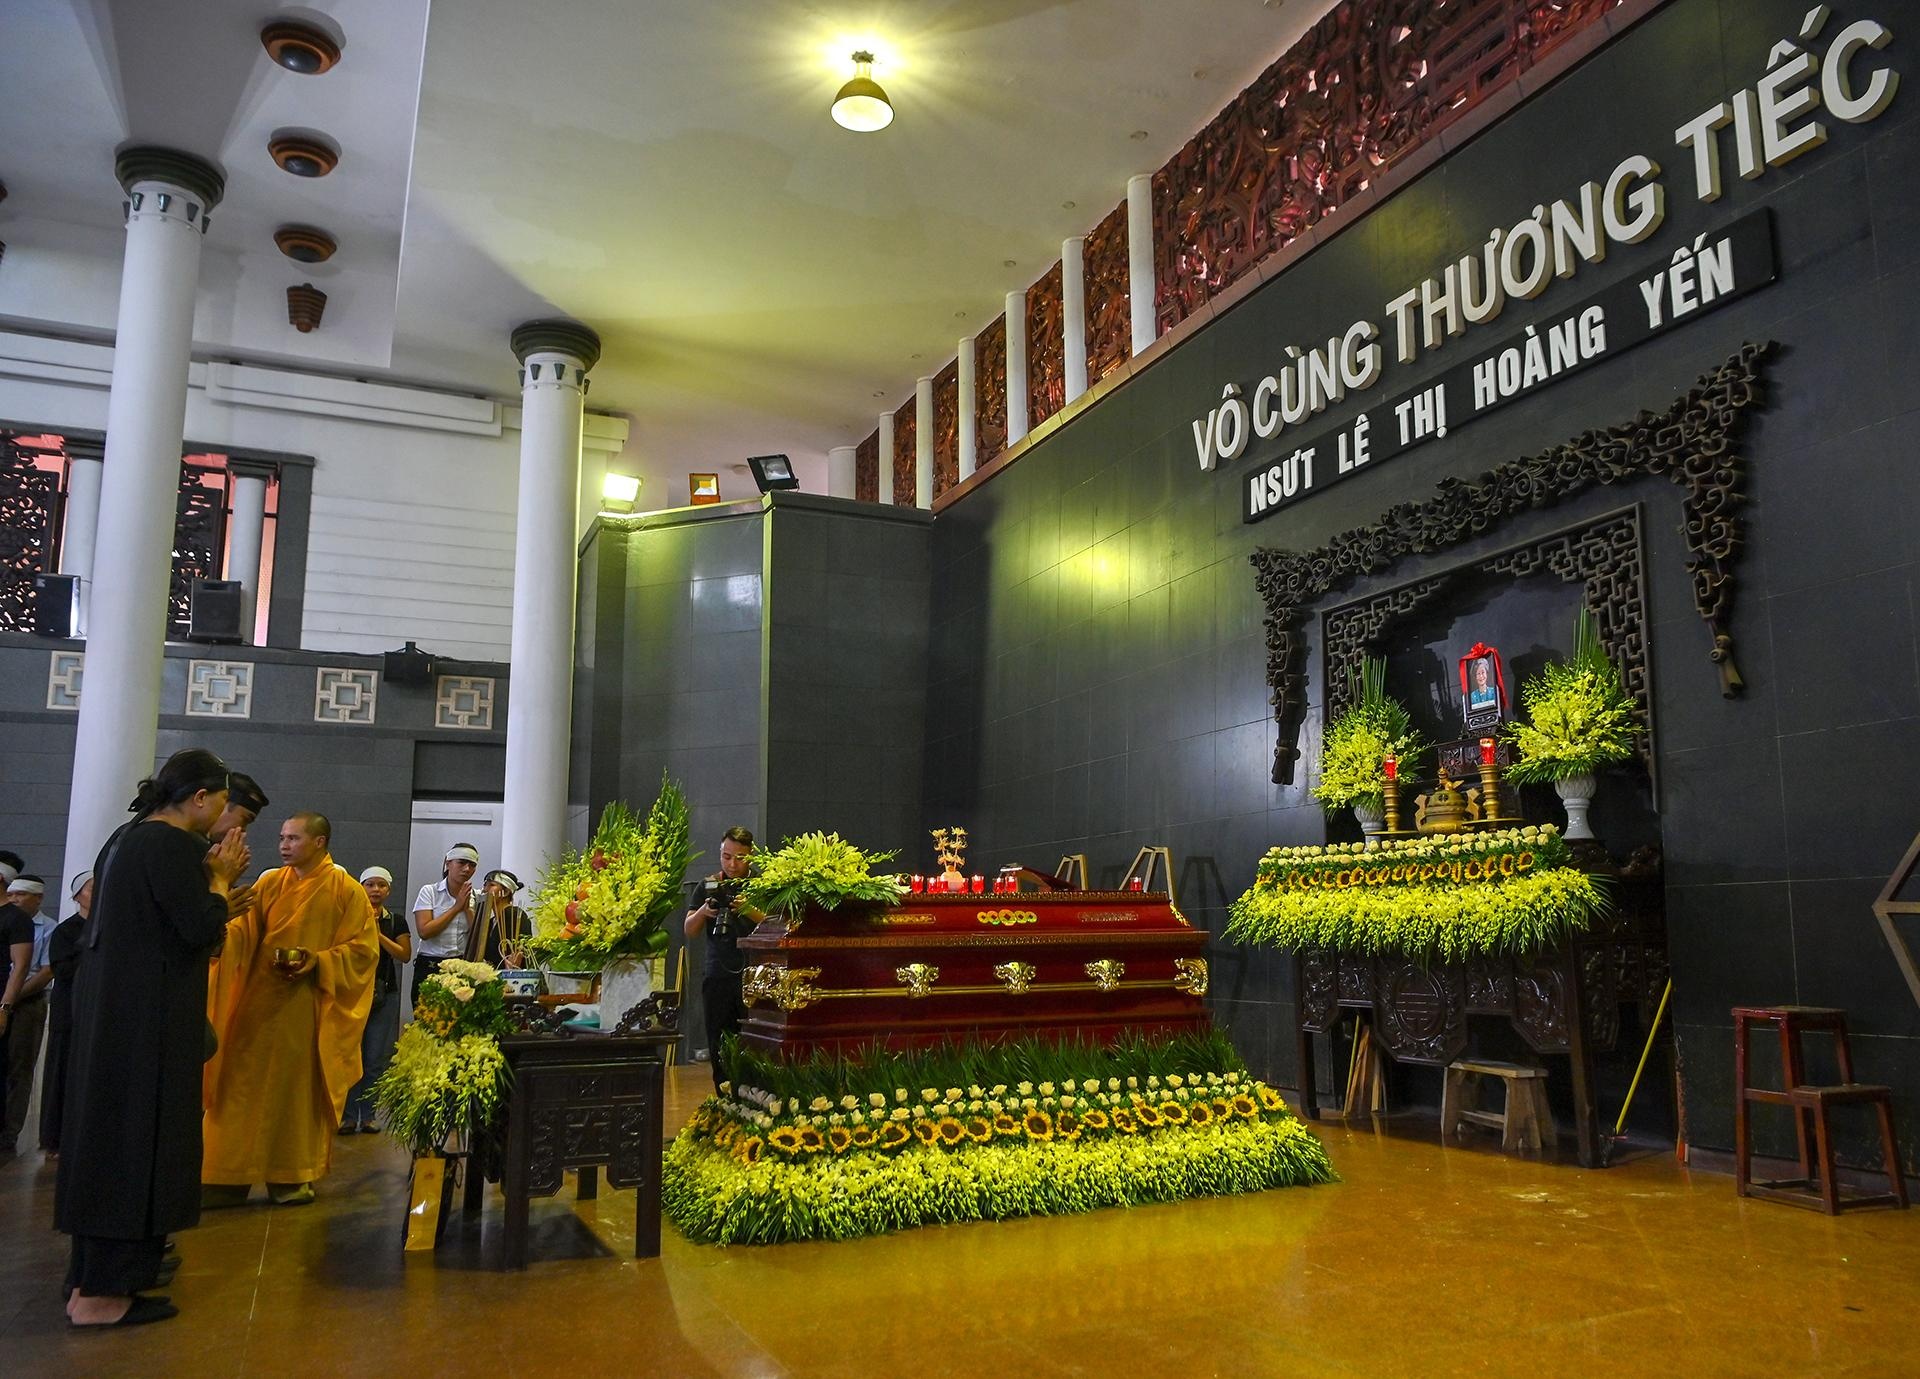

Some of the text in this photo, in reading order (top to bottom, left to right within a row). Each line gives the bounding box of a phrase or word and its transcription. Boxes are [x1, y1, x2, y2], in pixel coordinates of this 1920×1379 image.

[1192, 4, 1899, 472] VÔ CÙNG THƯƠNG TIẾC
[1250, 231, 1736, 515] NSƯT LÊ THỊ HOÀNG YẾN
